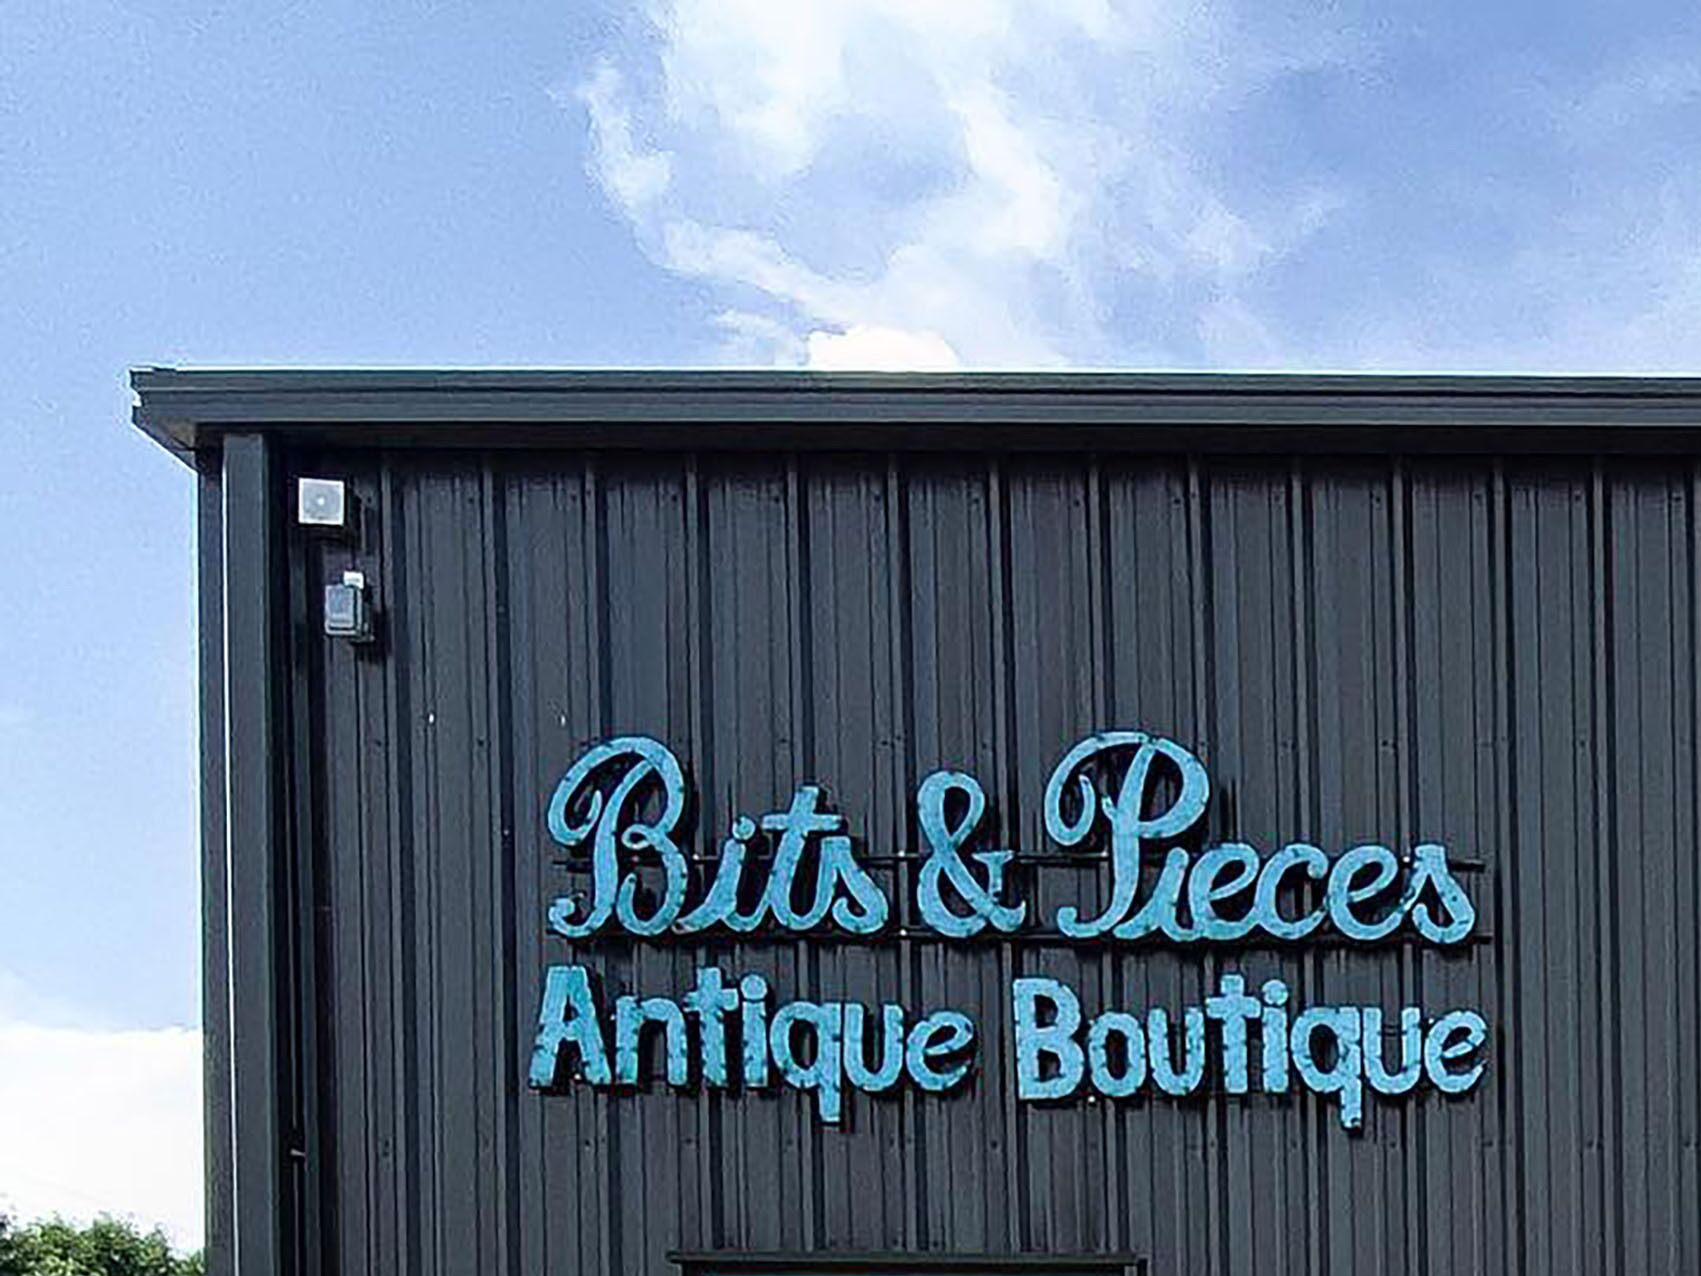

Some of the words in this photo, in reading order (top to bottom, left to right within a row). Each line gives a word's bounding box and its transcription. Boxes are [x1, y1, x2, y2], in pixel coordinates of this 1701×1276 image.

[547, 736, 888, 938] Bits
[916, 770, 1025, 938] &
[1044, 731, 1476, 943] Pieces
[528, 965, 975, 1123] Antique
[1012, 973, 1486, 1127] Boutique
